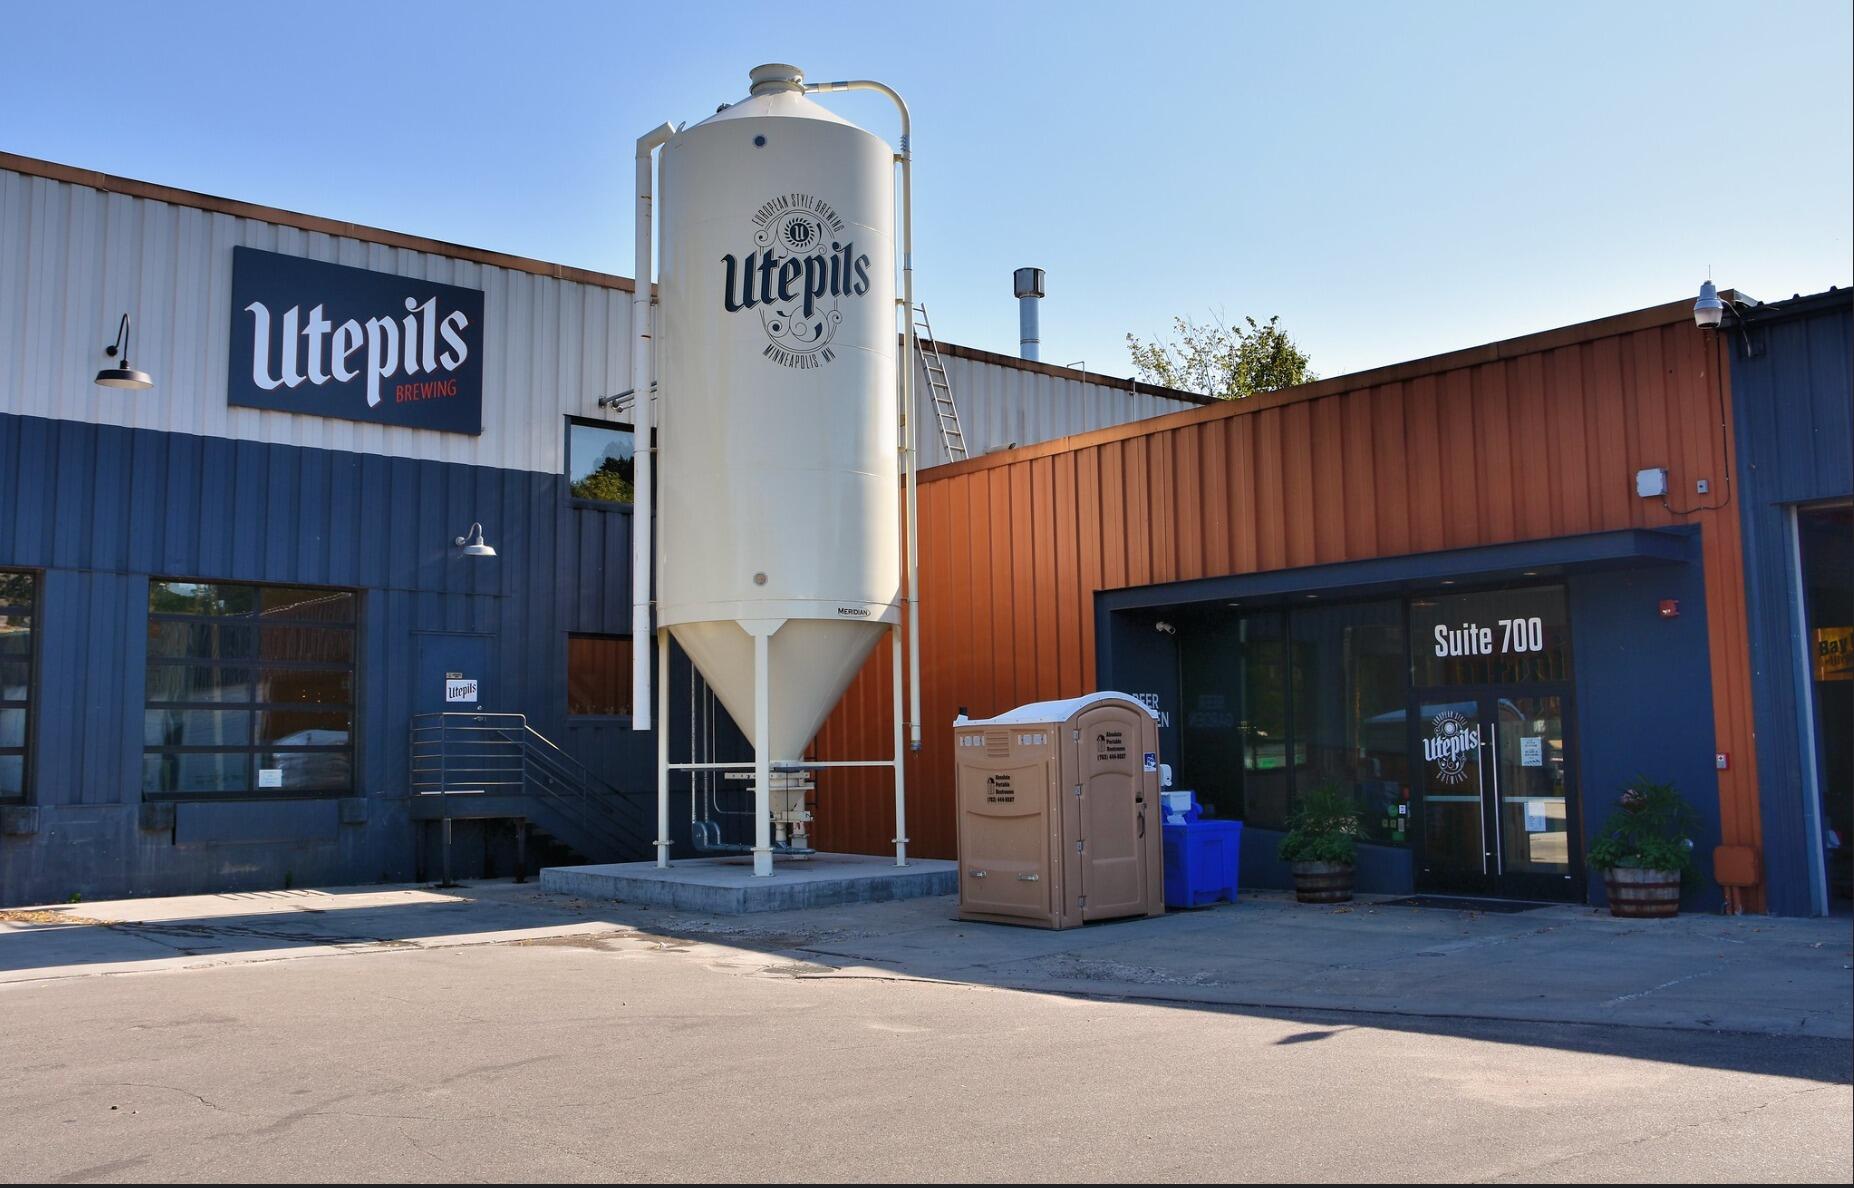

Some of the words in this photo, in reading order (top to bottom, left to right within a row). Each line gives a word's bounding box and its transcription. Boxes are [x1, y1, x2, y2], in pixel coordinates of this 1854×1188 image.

[752, 195, 788, 226] EUROPEAN
[791, 193, 814, 209] STYLE
[815, 199, 845, 232] BREWING
[720, 241, 871, 320] Utepils
[244, 296, 469, 408] Utepils
[821, 347, 836, 362] MN
[396, 379, 457, 403] BREWING
[1434, 623, 1493, 657] Suite
[1498, 617, 1543, 653] 700
[448, 682, 477, 699] Utepils
[1422, 727, 1478, 762] Utepils
